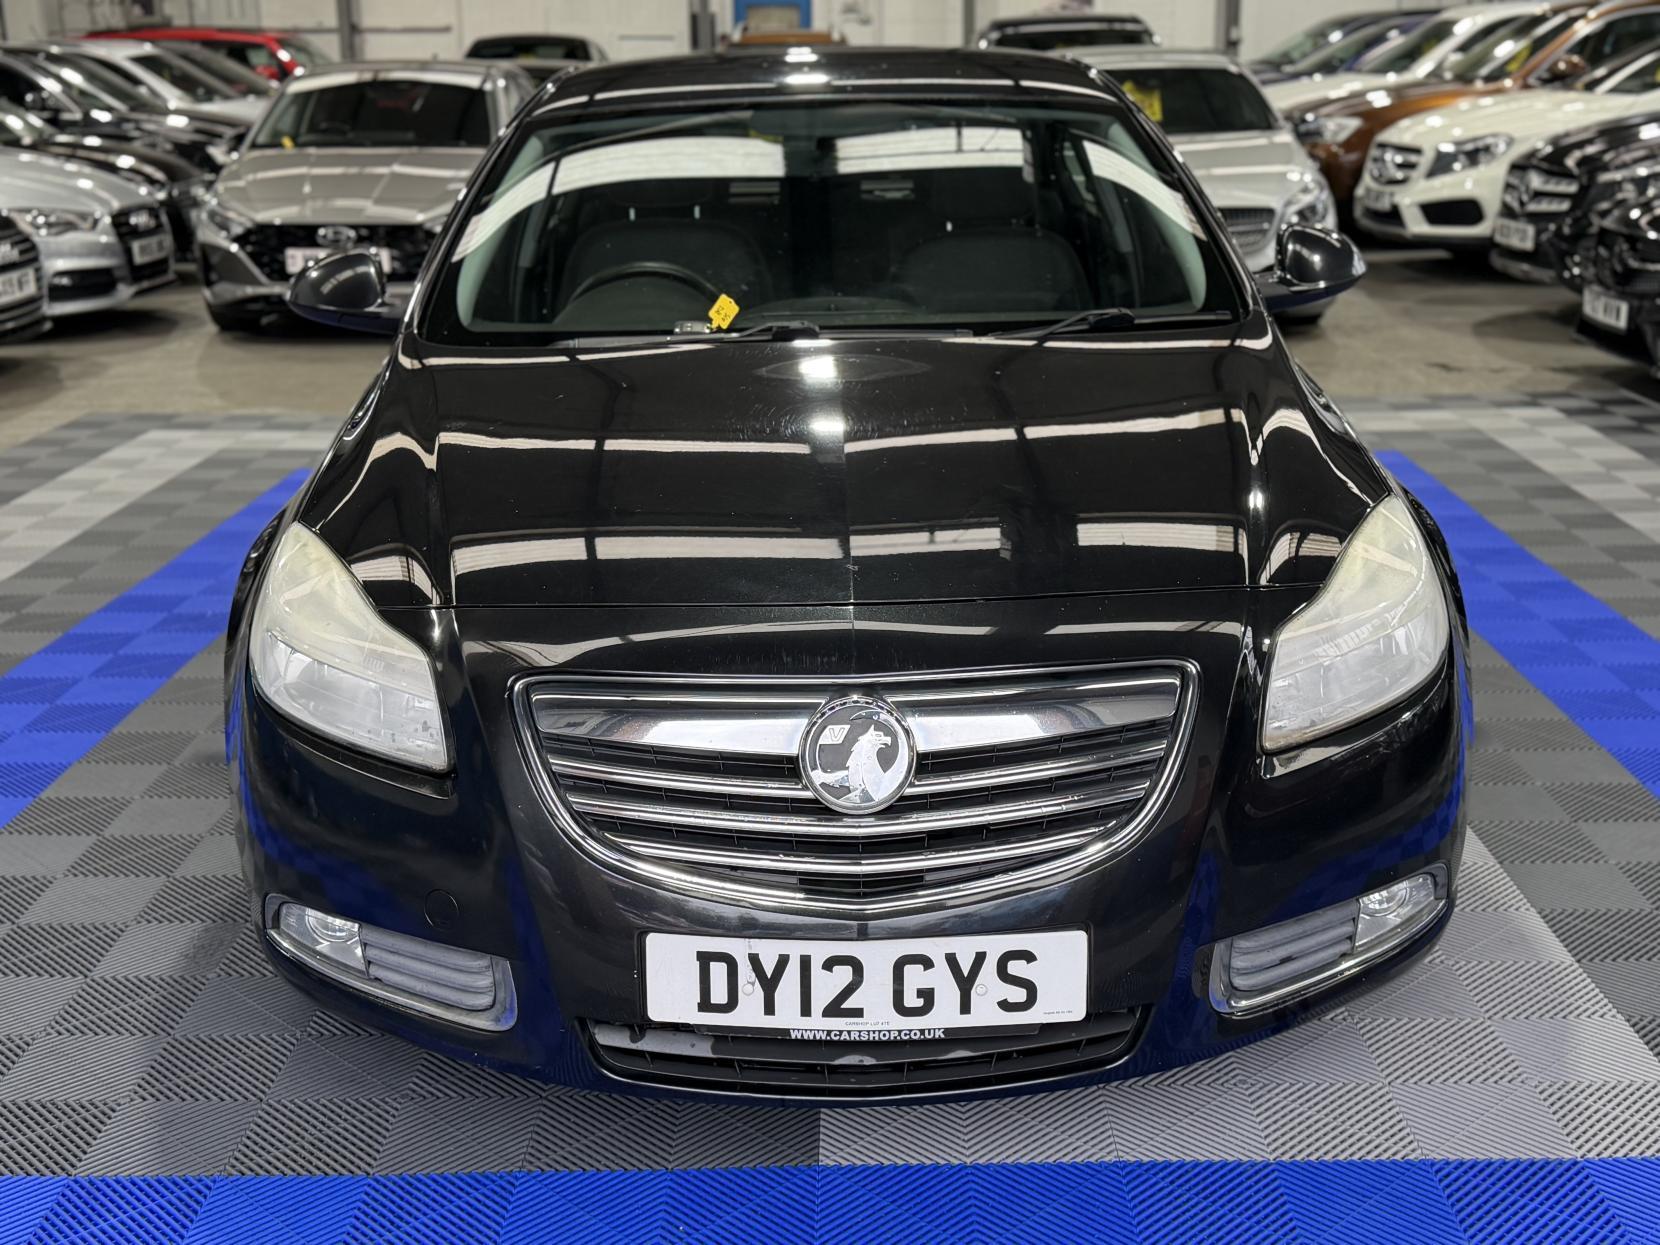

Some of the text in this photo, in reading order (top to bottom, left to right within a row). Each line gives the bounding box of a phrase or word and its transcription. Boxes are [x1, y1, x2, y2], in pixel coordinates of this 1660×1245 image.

[828, 727, 846, 742] V
[696, 949, 1038, 1018] DY12 GYS
[789, 1028, 945, 1041] WWW.CARSHOP.CO.UK
